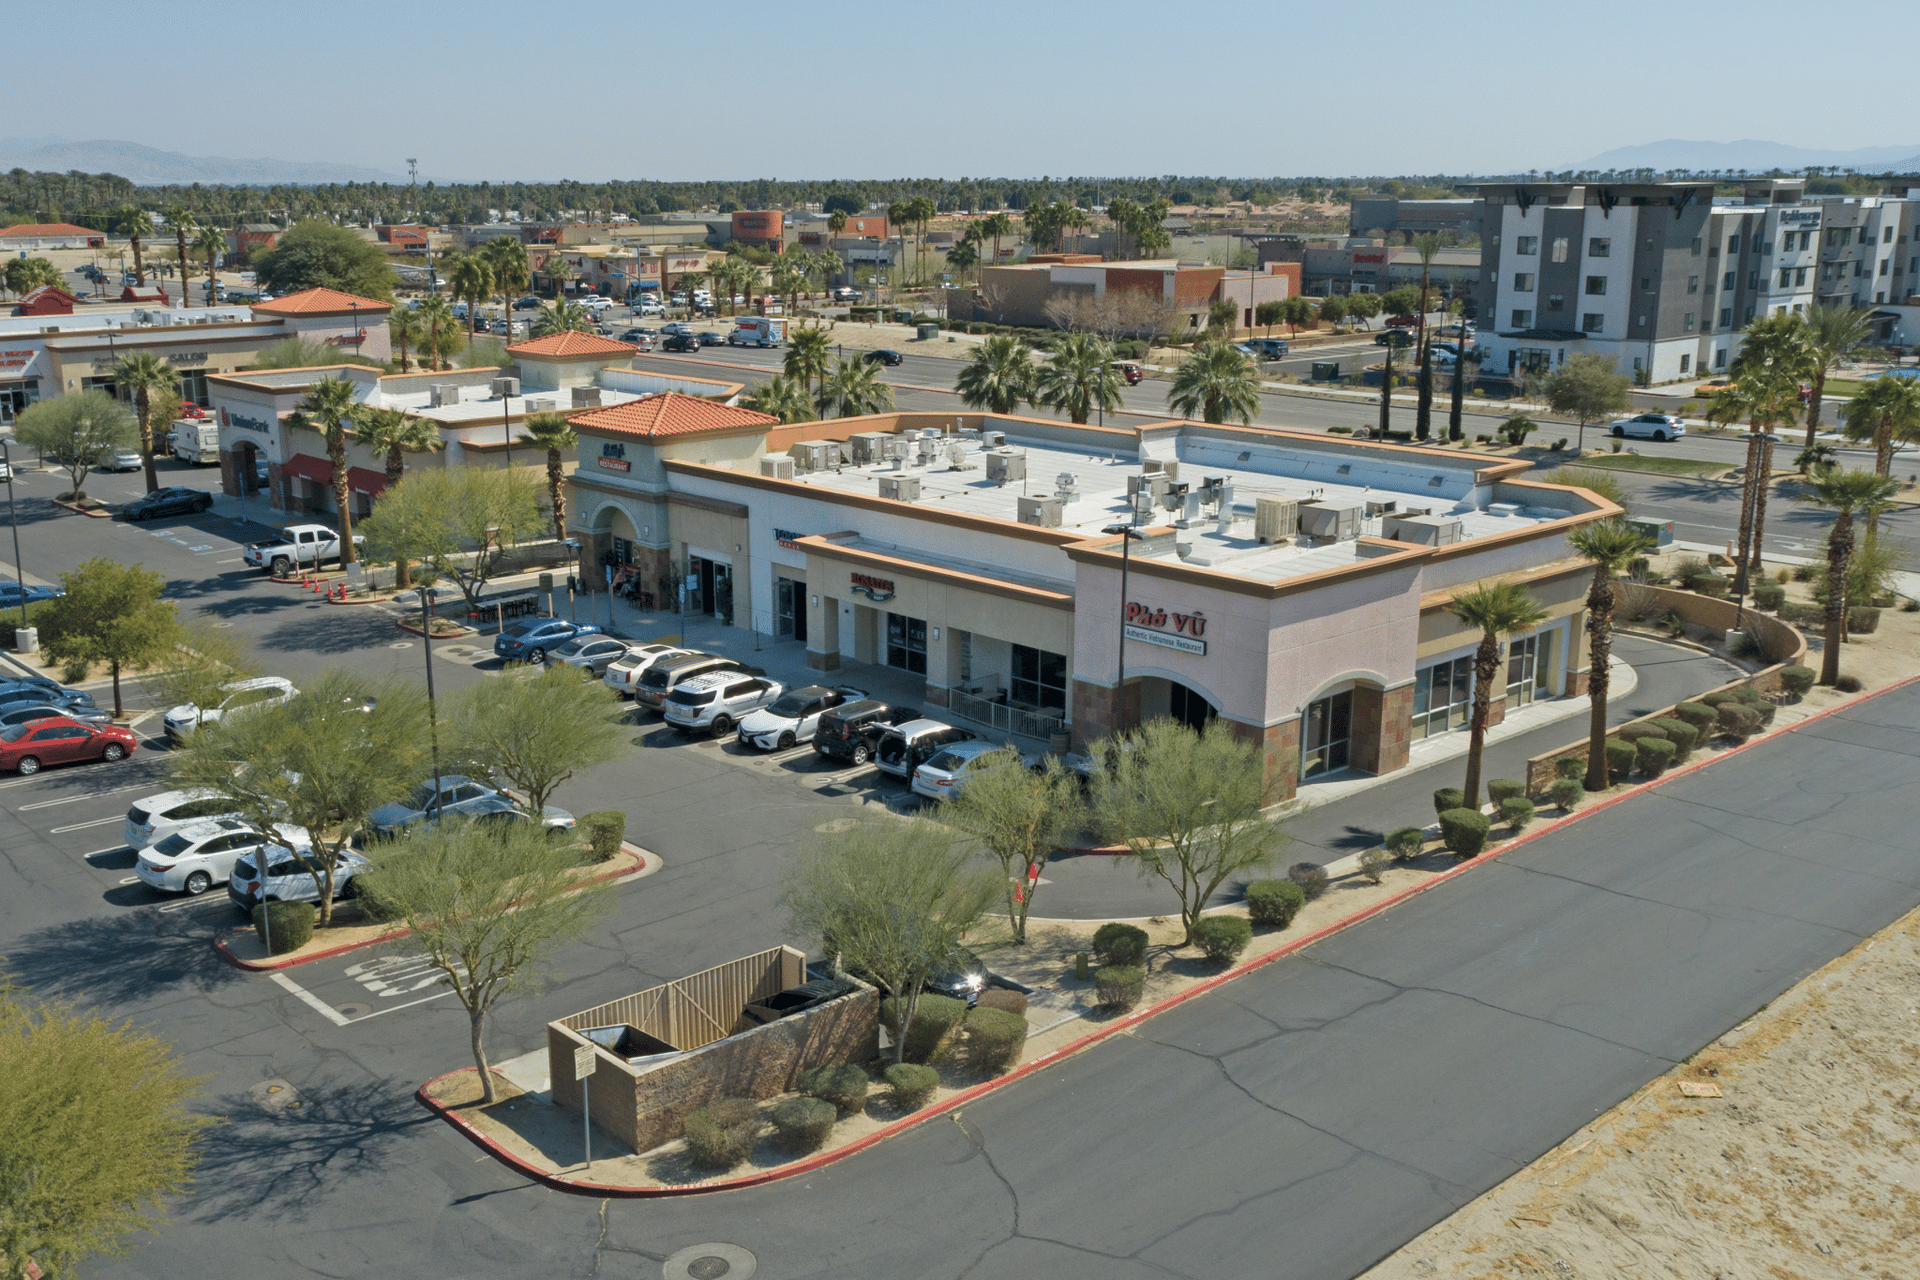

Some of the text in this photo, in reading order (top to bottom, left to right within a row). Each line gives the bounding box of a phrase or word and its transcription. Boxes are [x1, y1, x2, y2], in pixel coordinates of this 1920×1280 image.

[168, 352, 207, 363] SALON
[231, 413, 270, 434] UnionBank
[599, 460, 627, 471] RESTAURANT
[1126, 628, 1202, 652] Authentic Vietnamese Restaurant
